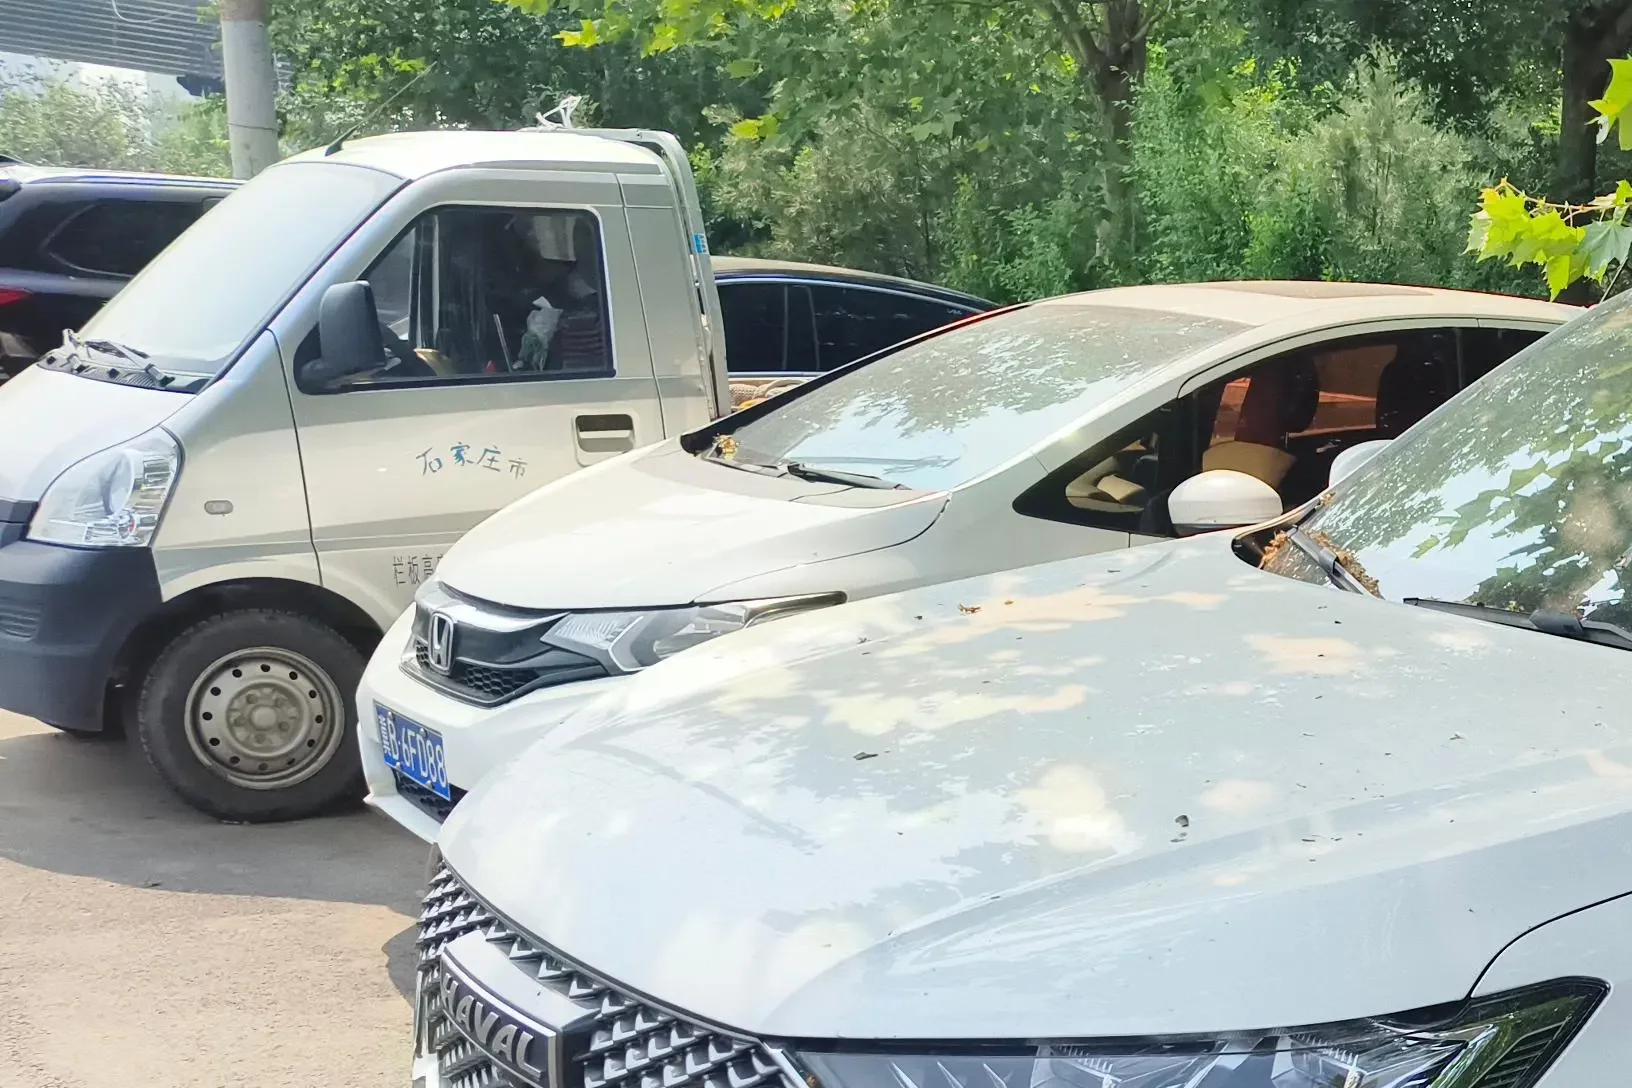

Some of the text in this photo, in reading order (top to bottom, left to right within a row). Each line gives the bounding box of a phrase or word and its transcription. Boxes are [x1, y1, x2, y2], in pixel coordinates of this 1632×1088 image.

[416, 442, 528, 479] 石家庄市
[392, 553, 444, 588] 栏板高
[441, 972, 543, 1081] HAVAL
